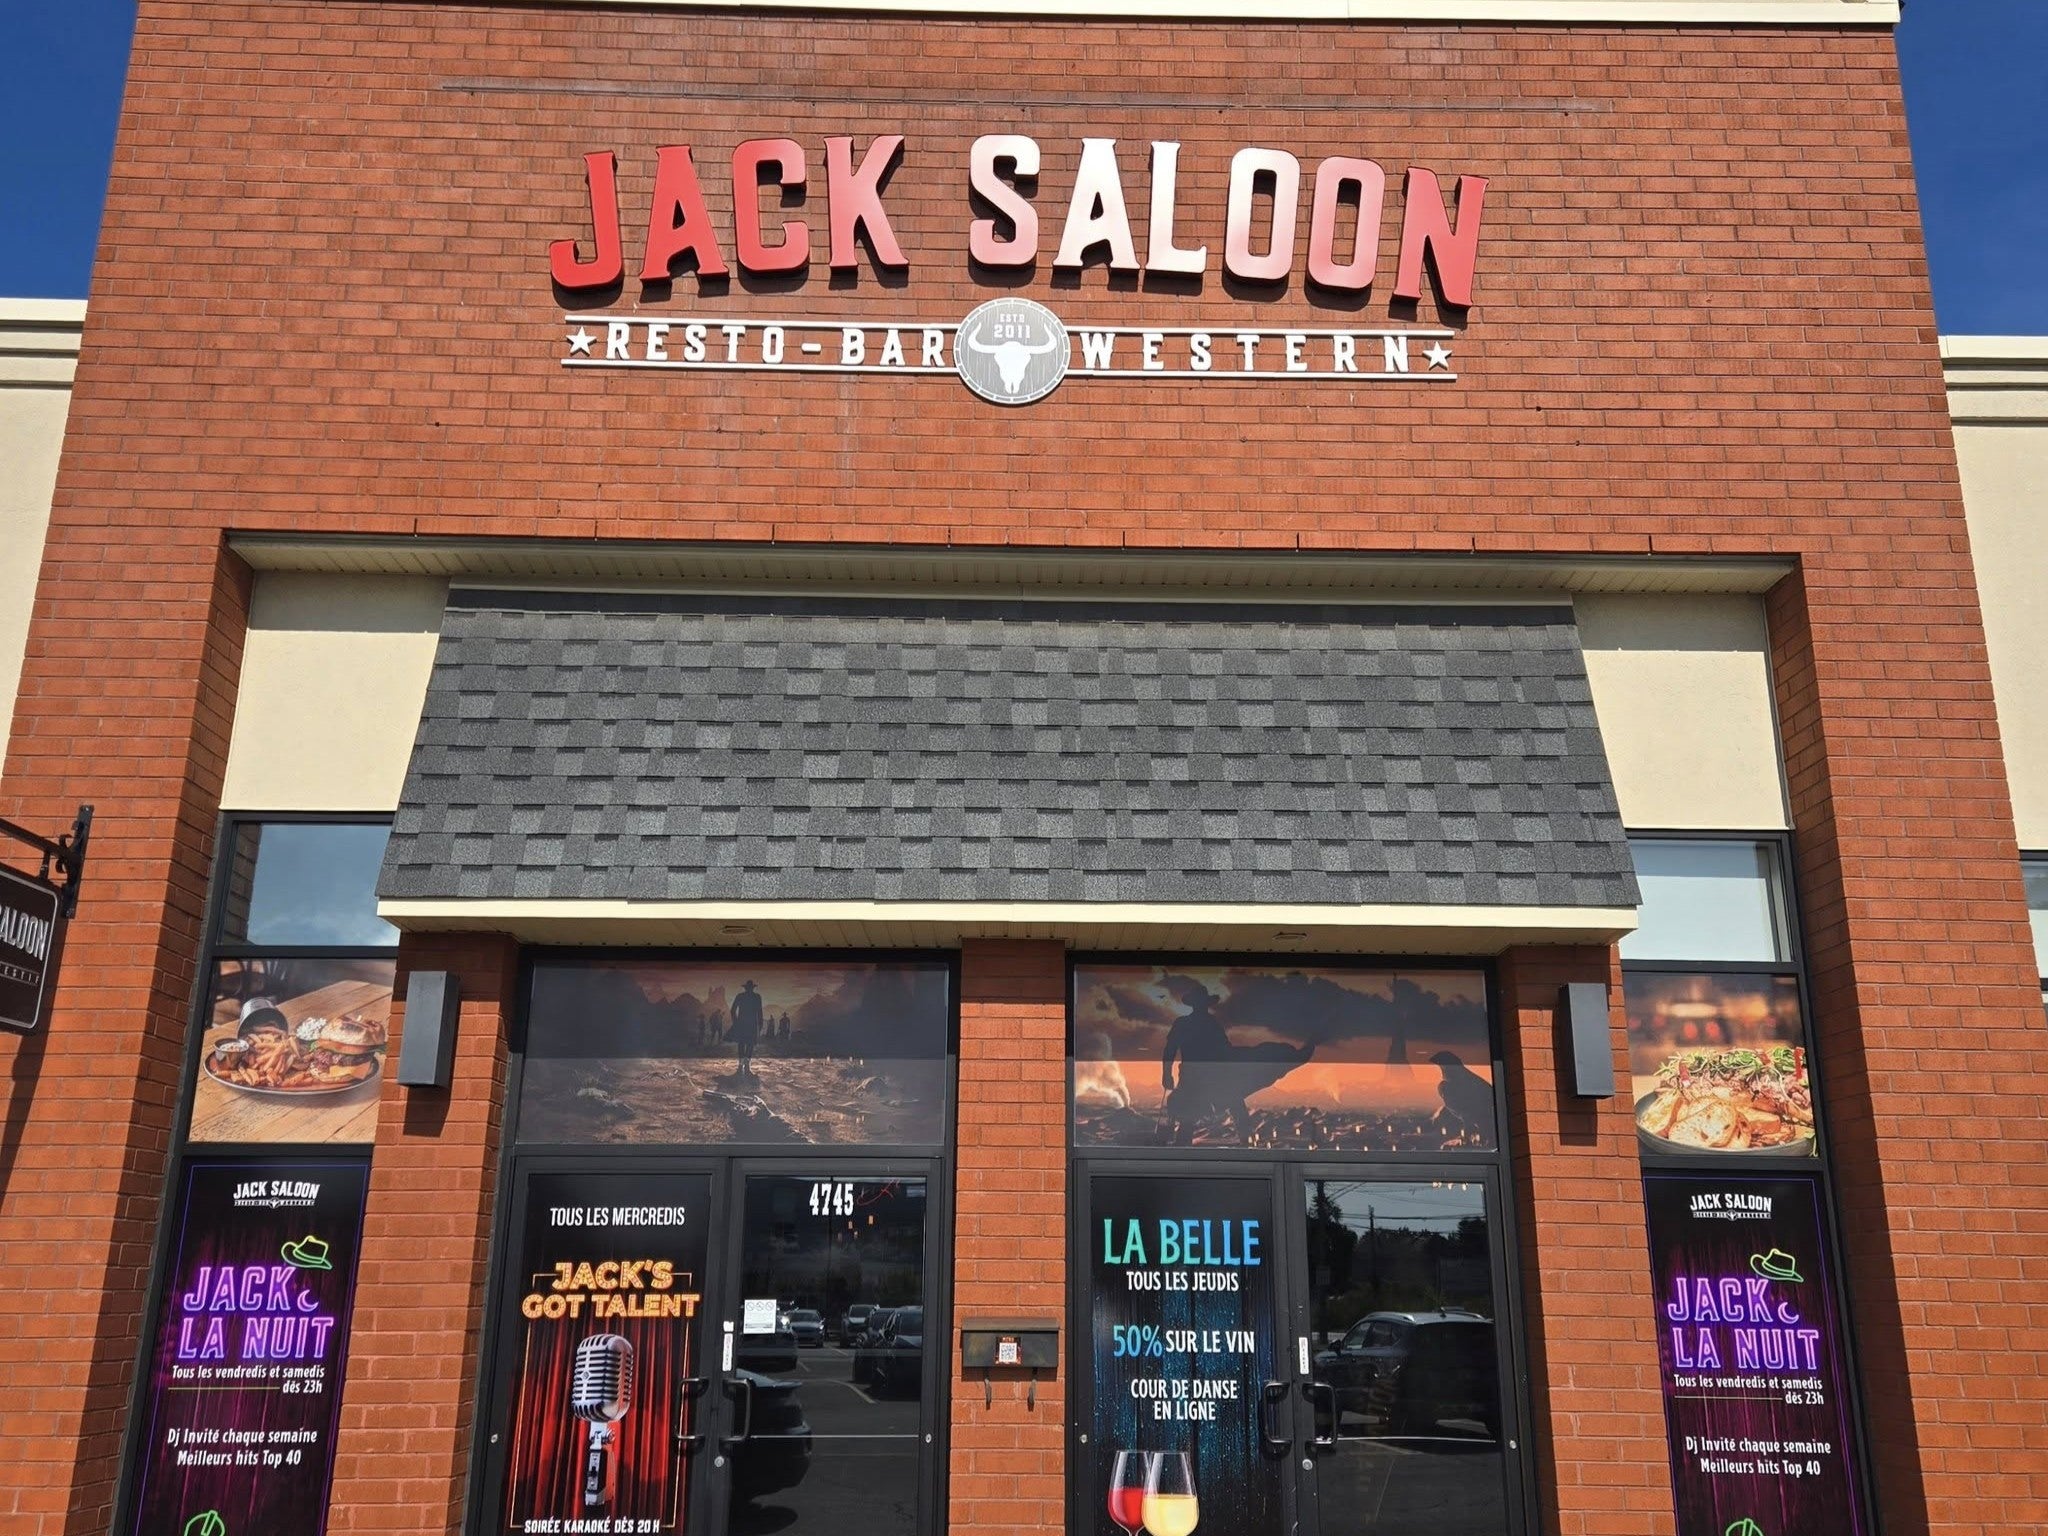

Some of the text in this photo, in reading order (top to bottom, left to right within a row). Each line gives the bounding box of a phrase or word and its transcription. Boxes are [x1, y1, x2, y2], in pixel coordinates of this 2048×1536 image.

[549, 134, 1489, 307] JACK SALOON
[993, 324, 1031, 339] 2011
[606, 322, 1409, 374] RESTO-BAR WESTERN
[0, 905, 49, 960] ALOON
[233, 1180, 321, 1200] JACK SALOON
[809, 1183, 854, 1216] 4745
[1690, 1193, 1772, 1213] JACK SALOON
[550, 1206, 685, 1226] TOUS LES MERCREDIS
[1103, 1218, 1261, 1265] LA BELLE
[552, 1259, 674, 1291] JACK'S
[1126, 1271, 1240, 1292] TOUS LES JEUDIS
[183, 1266, 296, 1311] JACK
[521, 1294, 700, 1319] GOT TALENT
[1667, 1277, 1773, 1322] JACK
[178, 1316, 334, 1359] LA NUIT
[1113, 1324, 1255, 1357] 50% SUR LE VIN
[1672, 1327, 1819, 1370] LA NUIT
[172, 1364, 325, 1378] Tous les vendredis et samedis
[302, 1380, 323, 1393] 23h
[1131, 1379, 1238, 1399] COUR DE DANSE
[1674, 1374, 1823, 1389] Tous les vendredis et samedis
[1804, 1391, 1824, 1405] 23h
[1154, 1401, 1216, 1420] EN LIGNE
[167, 1427, 317, 1447] Dj Invité chaque semaine
[1685, 1436, 1831, 1455] Dj Invité chaque semaine
[177, 1450, 301, 1469] Meilleurs hits Top 40
[1700, 1458, 1821, 1478] Meilleurs hits Top 40
[524, 1516, 561, 1533] SOIRÉE
[563, 1516, 610, 1533] KARAOKÉ
[637, 1519, 651, 1533] 20
[652, 1519, 660, 1533] H
